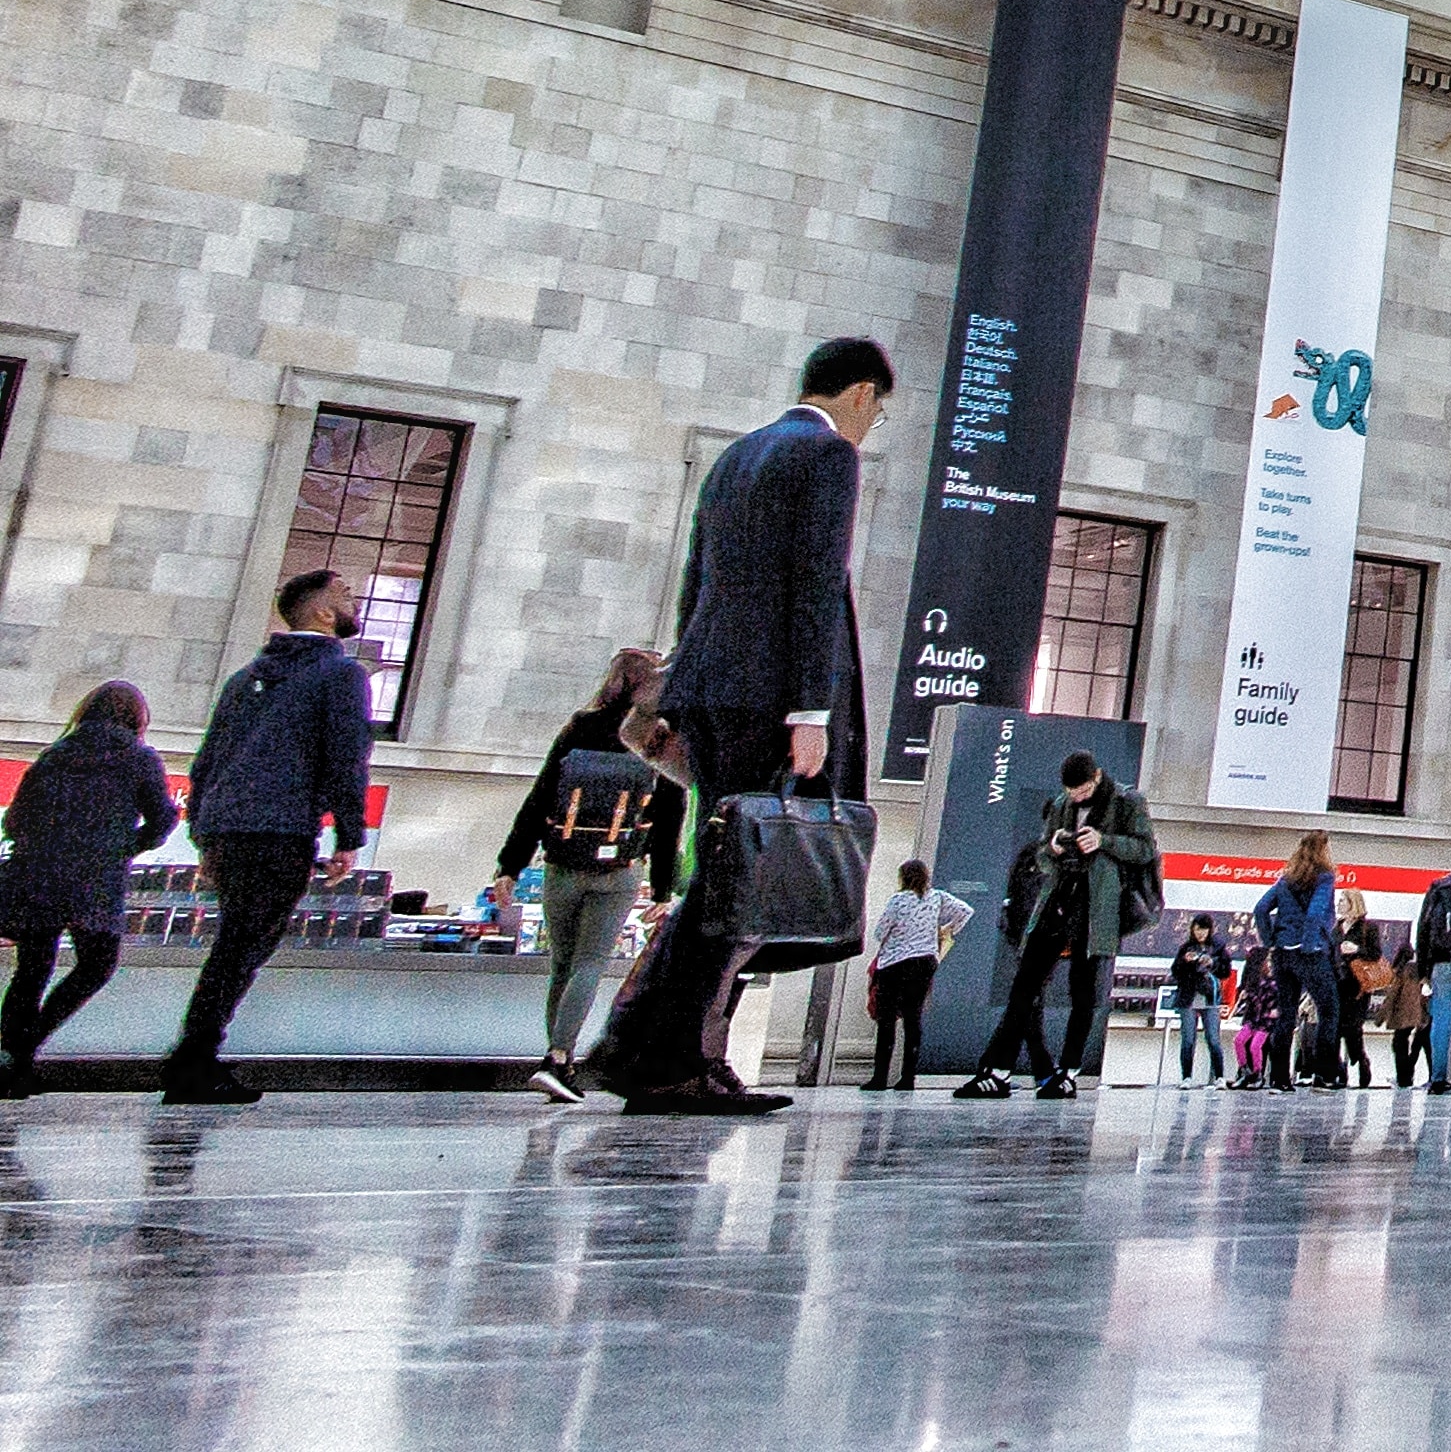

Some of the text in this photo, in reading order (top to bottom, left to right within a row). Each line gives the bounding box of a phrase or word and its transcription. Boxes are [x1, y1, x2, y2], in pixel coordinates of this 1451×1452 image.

[970, 314, 1018, 332] English.
[965, 342, 1019, 360] Deutsch.
[963, 355, 1012, 373] Italiano.
[958, 382, 1013, 402] Français.
[1265, 449, 1303, 464] Explore
[946, 466, 971, 480] The
[1263, 462, 1308, 477] together.
[943, 480, 1036, 504] British Museum
[1261, 487, 1312, 505] Take turns
[941, 498, 996, 515] your way
[1258, 501, 1269, 511] to
[1256, 527, 1299, 542] Beat the
[917, 644, 986, 671] Audio
[914, 674, 979, 698] guide
[1237, 677, 1300, 706] Family
[1234, 705, 1289, 727] guide
[1001, 719, 1015, 741] on
[1201, 862, 1232, 877] Audio
[1233, 866, 1262, 880] guide
